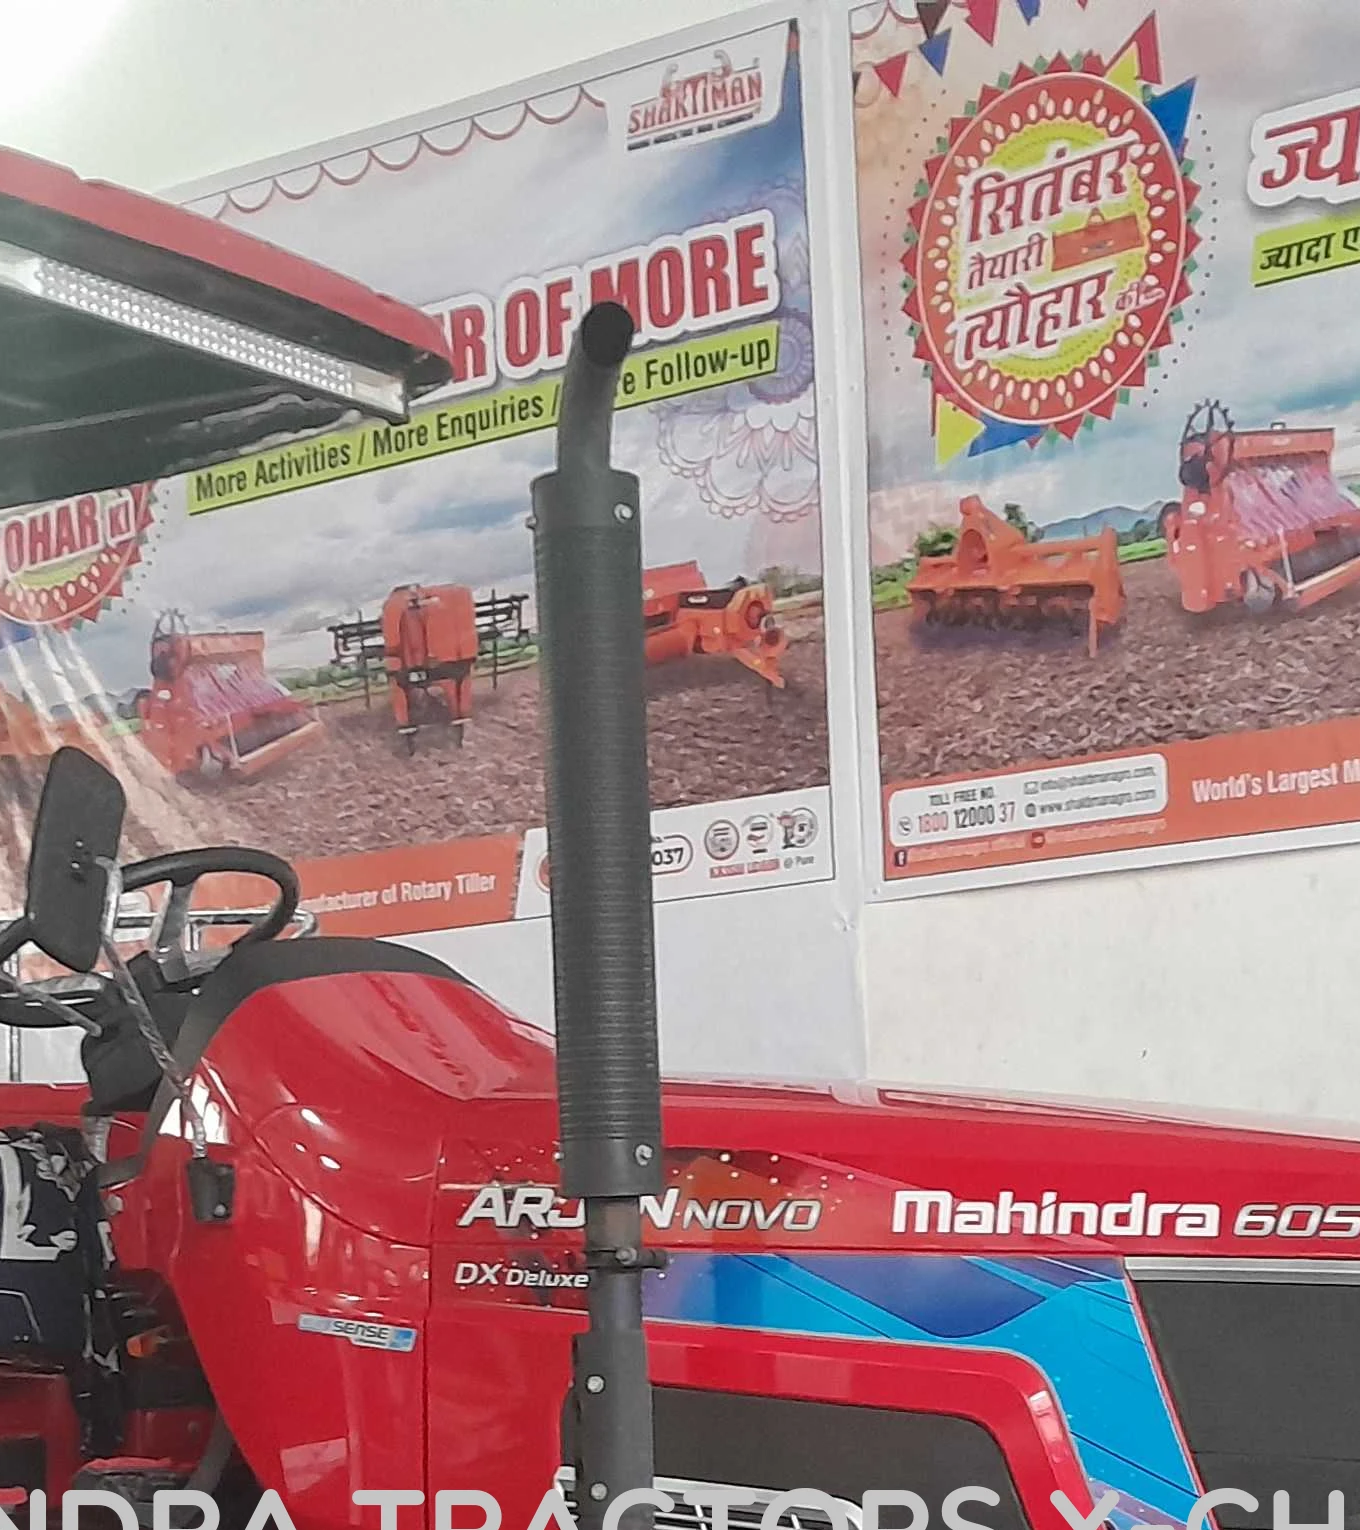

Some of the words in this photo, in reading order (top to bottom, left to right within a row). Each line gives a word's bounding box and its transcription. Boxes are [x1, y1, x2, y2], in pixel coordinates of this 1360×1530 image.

[627, 70, 762, 134] SHAKTIMAN
[967, 140, 1136, 243] सितंबर
[967, 232, 1048, 290] तैयारी
[1259, 231, 1338, 271] ज्यादा
[505, 276, 574, 368] OF
[195, 469, 248, 502] More
[254, 441, 352, 488] Activities
[373, 425, 429, 459] More
[437, 394, 545, 441] Enquiries
[645, 337, 771, 390] Follow-up
[1192, 773, 1262, 803] World's
[1266, 763, 1339, 795] Largest
[999, 801, 1016, 823] 37
[401, 880, 452, 902] Rotary
[457, 1186, 680, 1230] ARJN
[682, 1198, 823, 1232] NOVO
[891, 1190, 1221, 1238] Mahindra
[454, 1262, 505, 1285] DX
[505, 1267, 590, 1289] Deluxe
